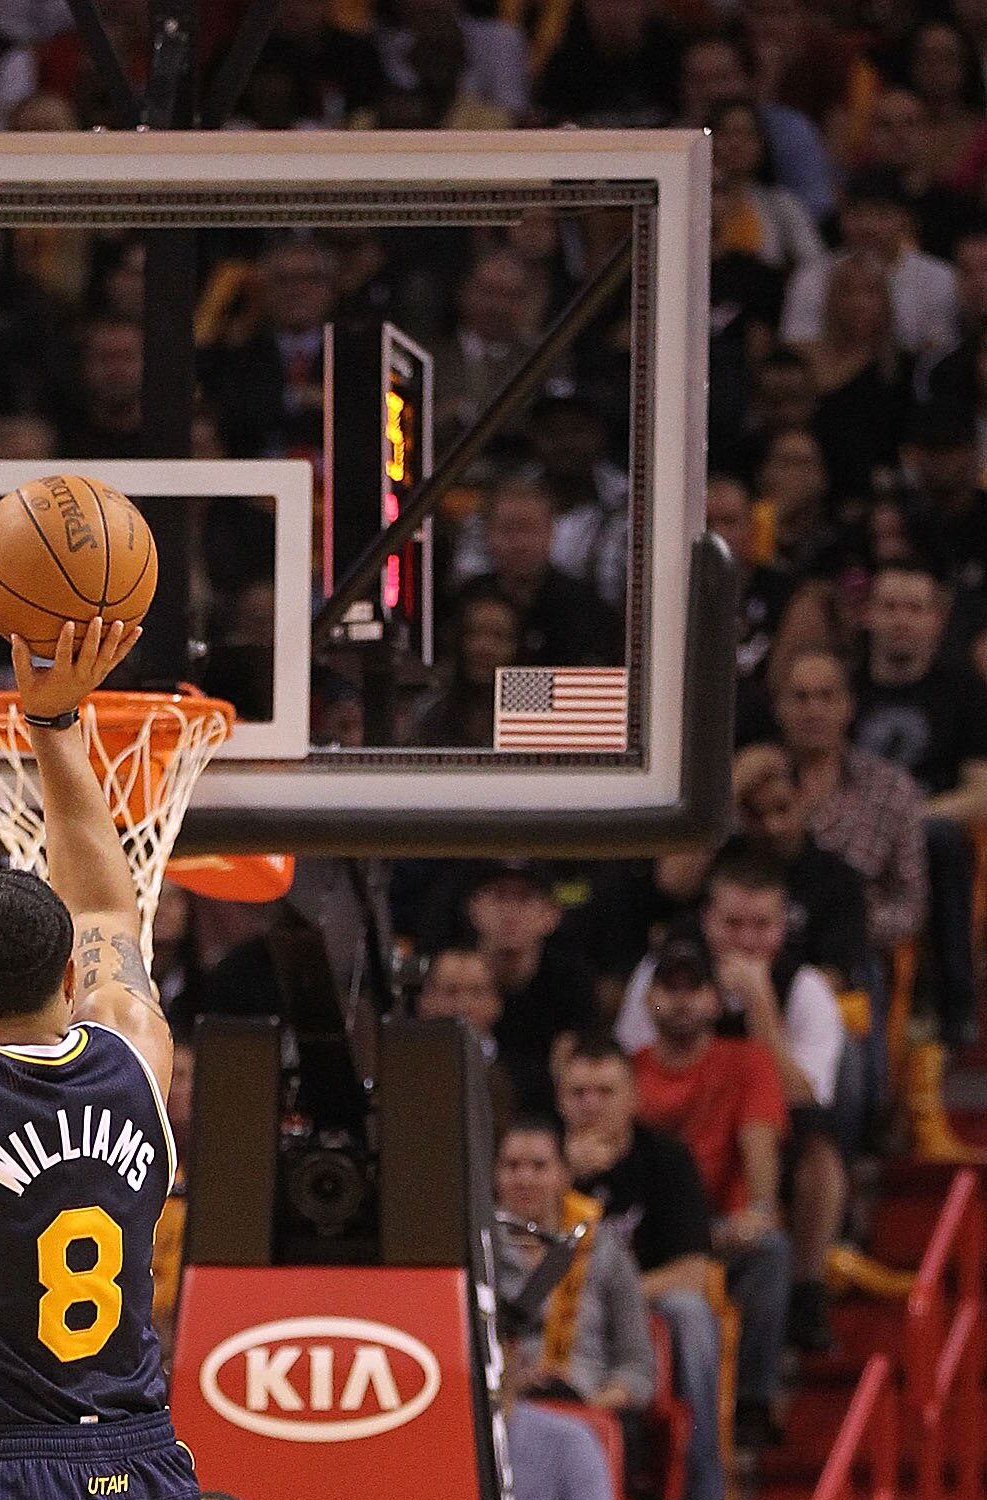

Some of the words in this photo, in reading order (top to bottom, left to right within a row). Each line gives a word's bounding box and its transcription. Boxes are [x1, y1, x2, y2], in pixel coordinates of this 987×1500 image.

[37, 1205, 123, 1363] 8
[245, 1346, 403, 1411] KIA
[88, 1474, 129, 1496] UTAH
